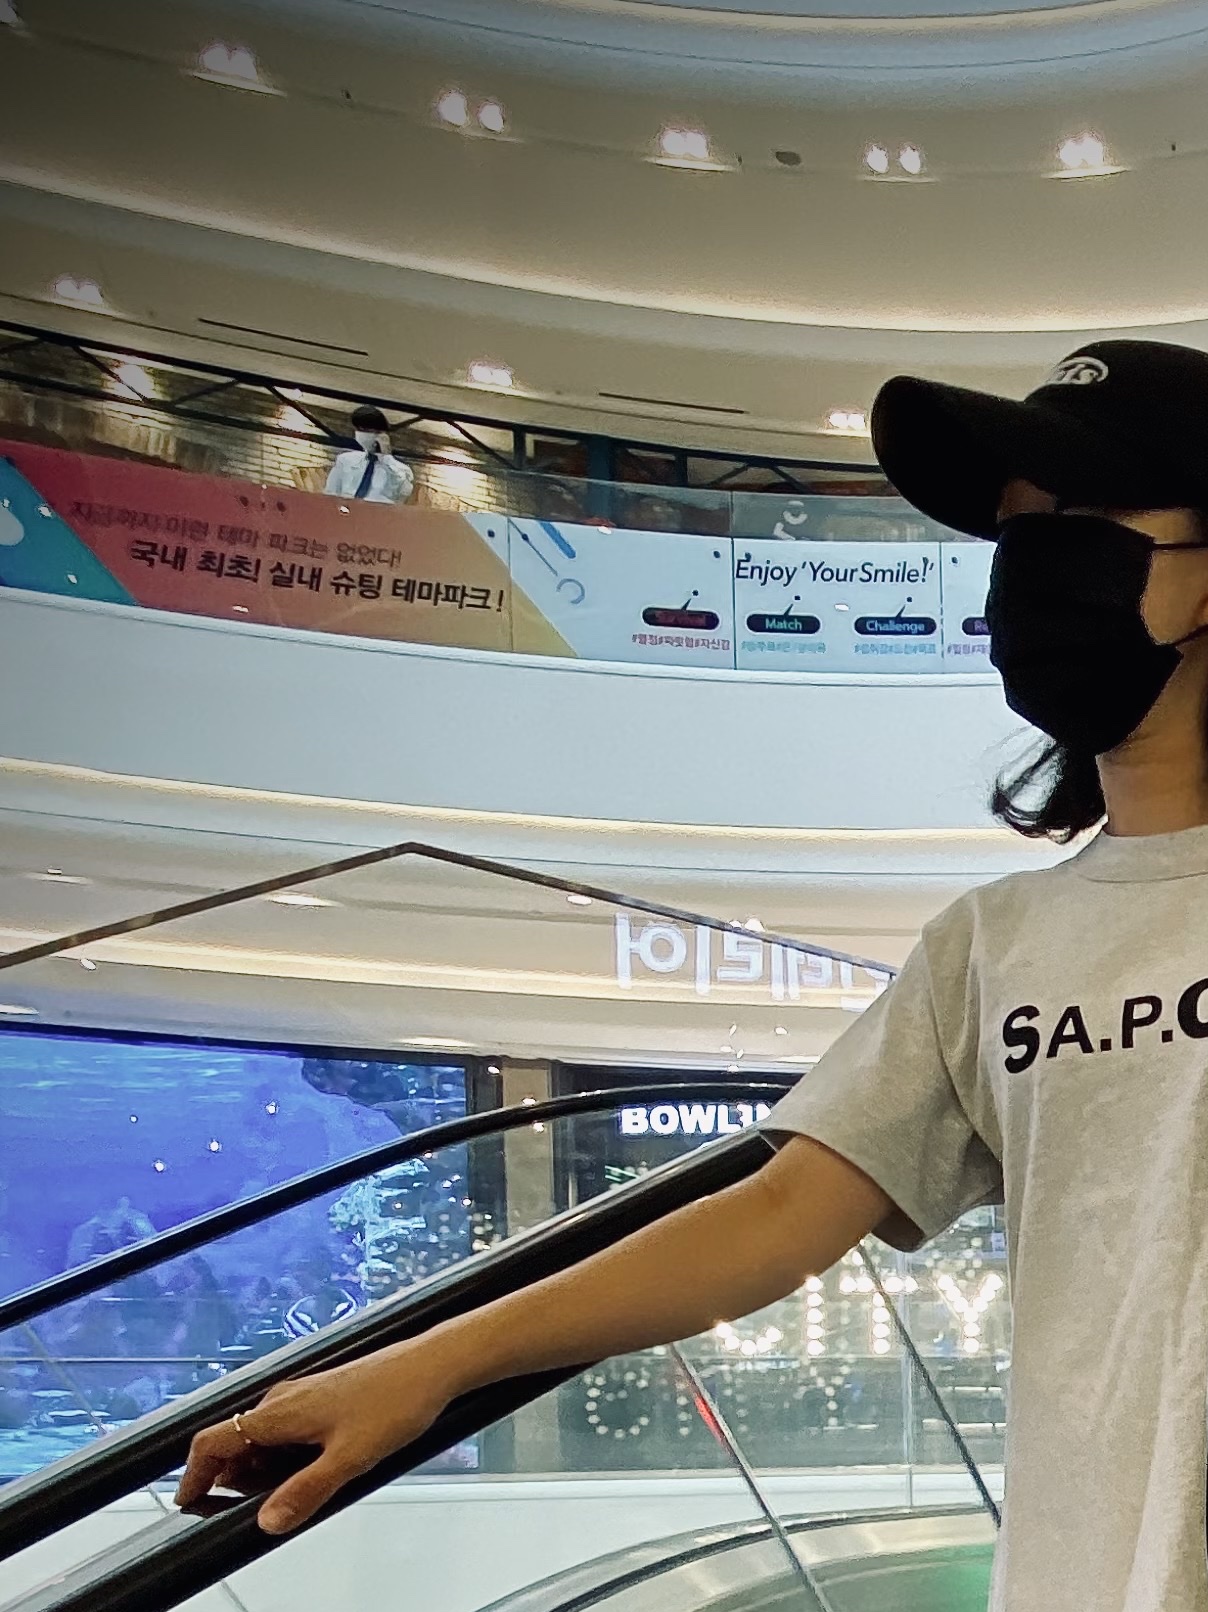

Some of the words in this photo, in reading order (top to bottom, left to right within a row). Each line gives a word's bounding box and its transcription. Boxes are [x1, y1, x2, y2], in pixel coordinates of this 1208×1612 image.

[130, 539, 188, 574] 국내
[197, 545, 261, 582] 최초!
[269, 559, 324, 592] 실내
[331, 572, 382, 600] 슈팅
[391, 577, 506, 613] 테마파크!
[735, 557, 798, 587] Enjoy
[765, 617, 803, 632] Match
[865, 617, 926, 636] Challenge
